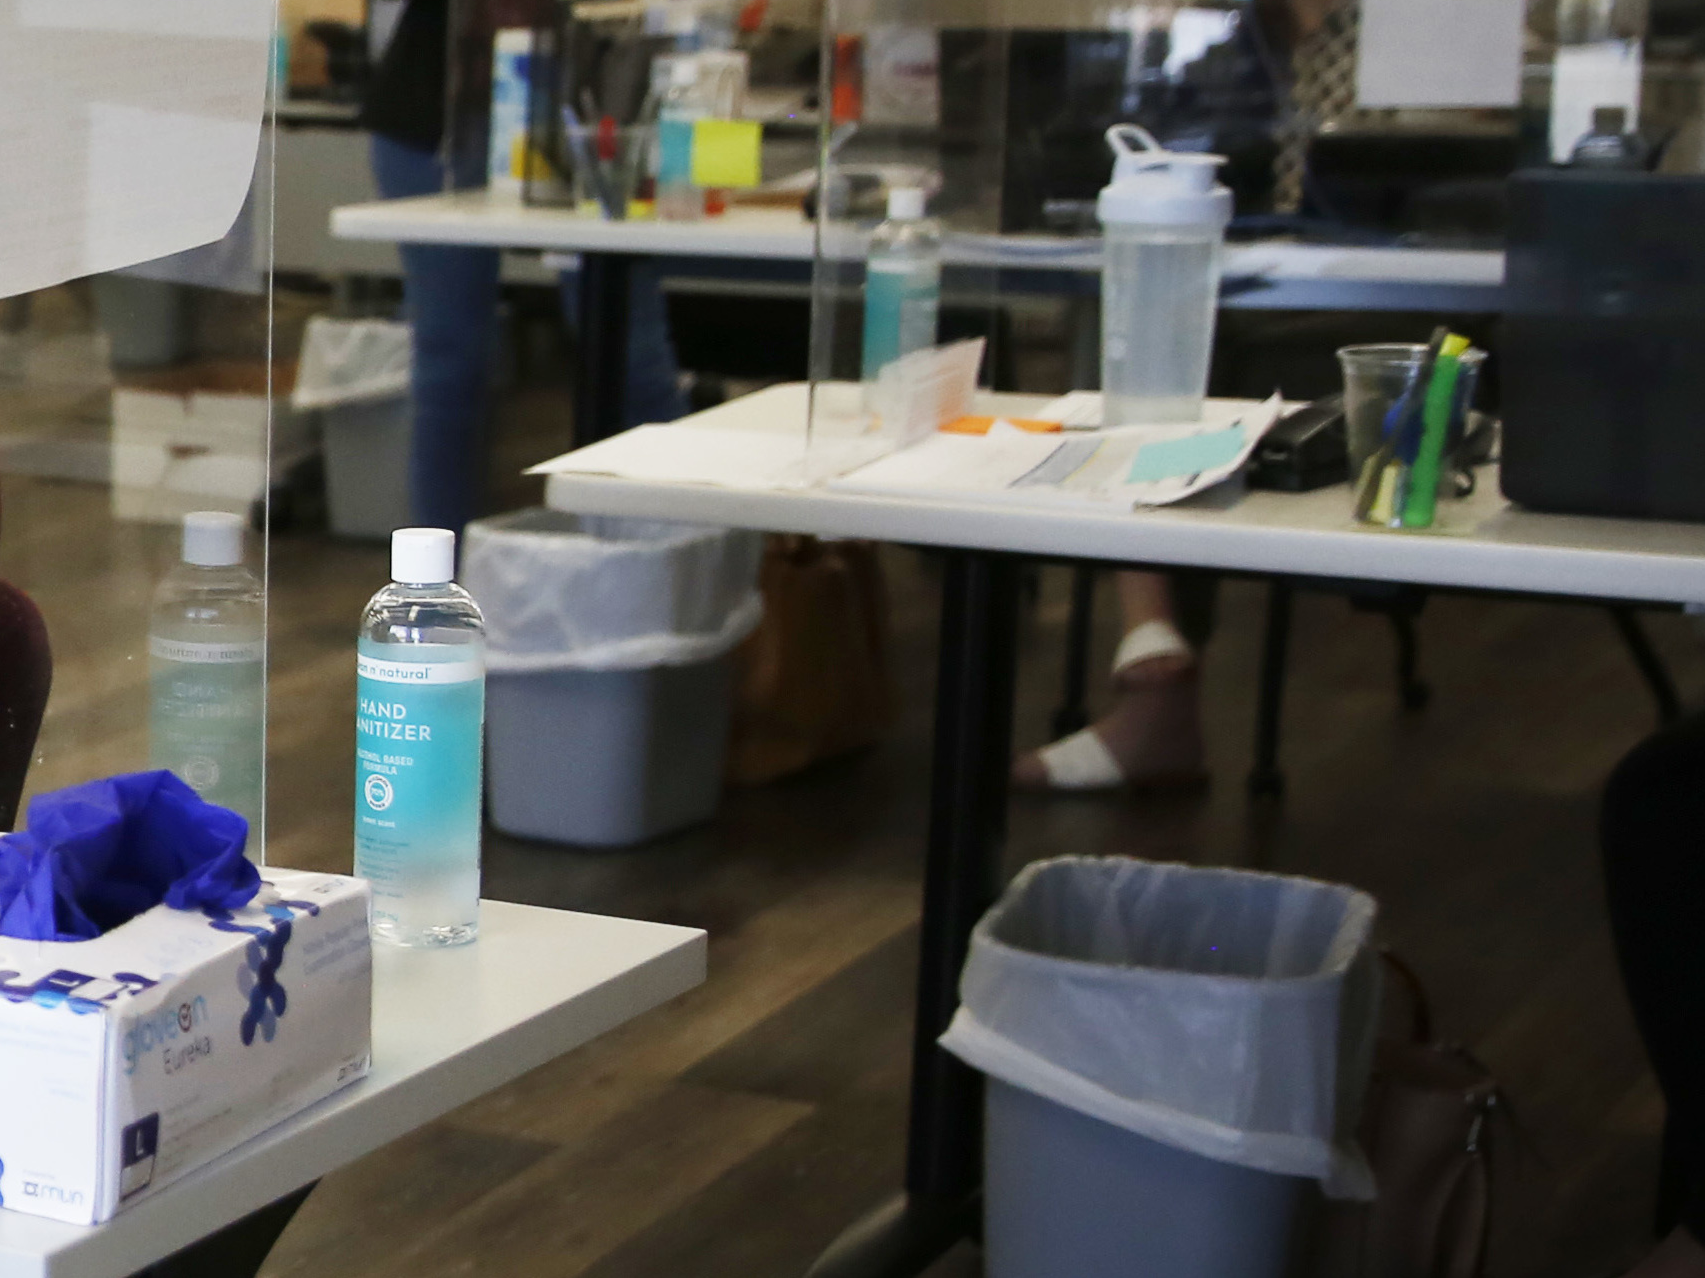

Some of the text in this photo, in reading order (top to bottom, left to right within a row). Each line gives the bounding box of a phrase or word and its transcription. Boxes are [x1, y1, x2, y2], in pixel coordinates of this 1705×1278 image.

[380, 668, 428, 680] natural
[360, 698, 407, 719] HAND
[357, 717, 432, 741] ANITIZER
[383, 755, 414, 766] BASED
[163, 1036, 211, 1075] Eureka
[136, 1128, 144, 1157] L
